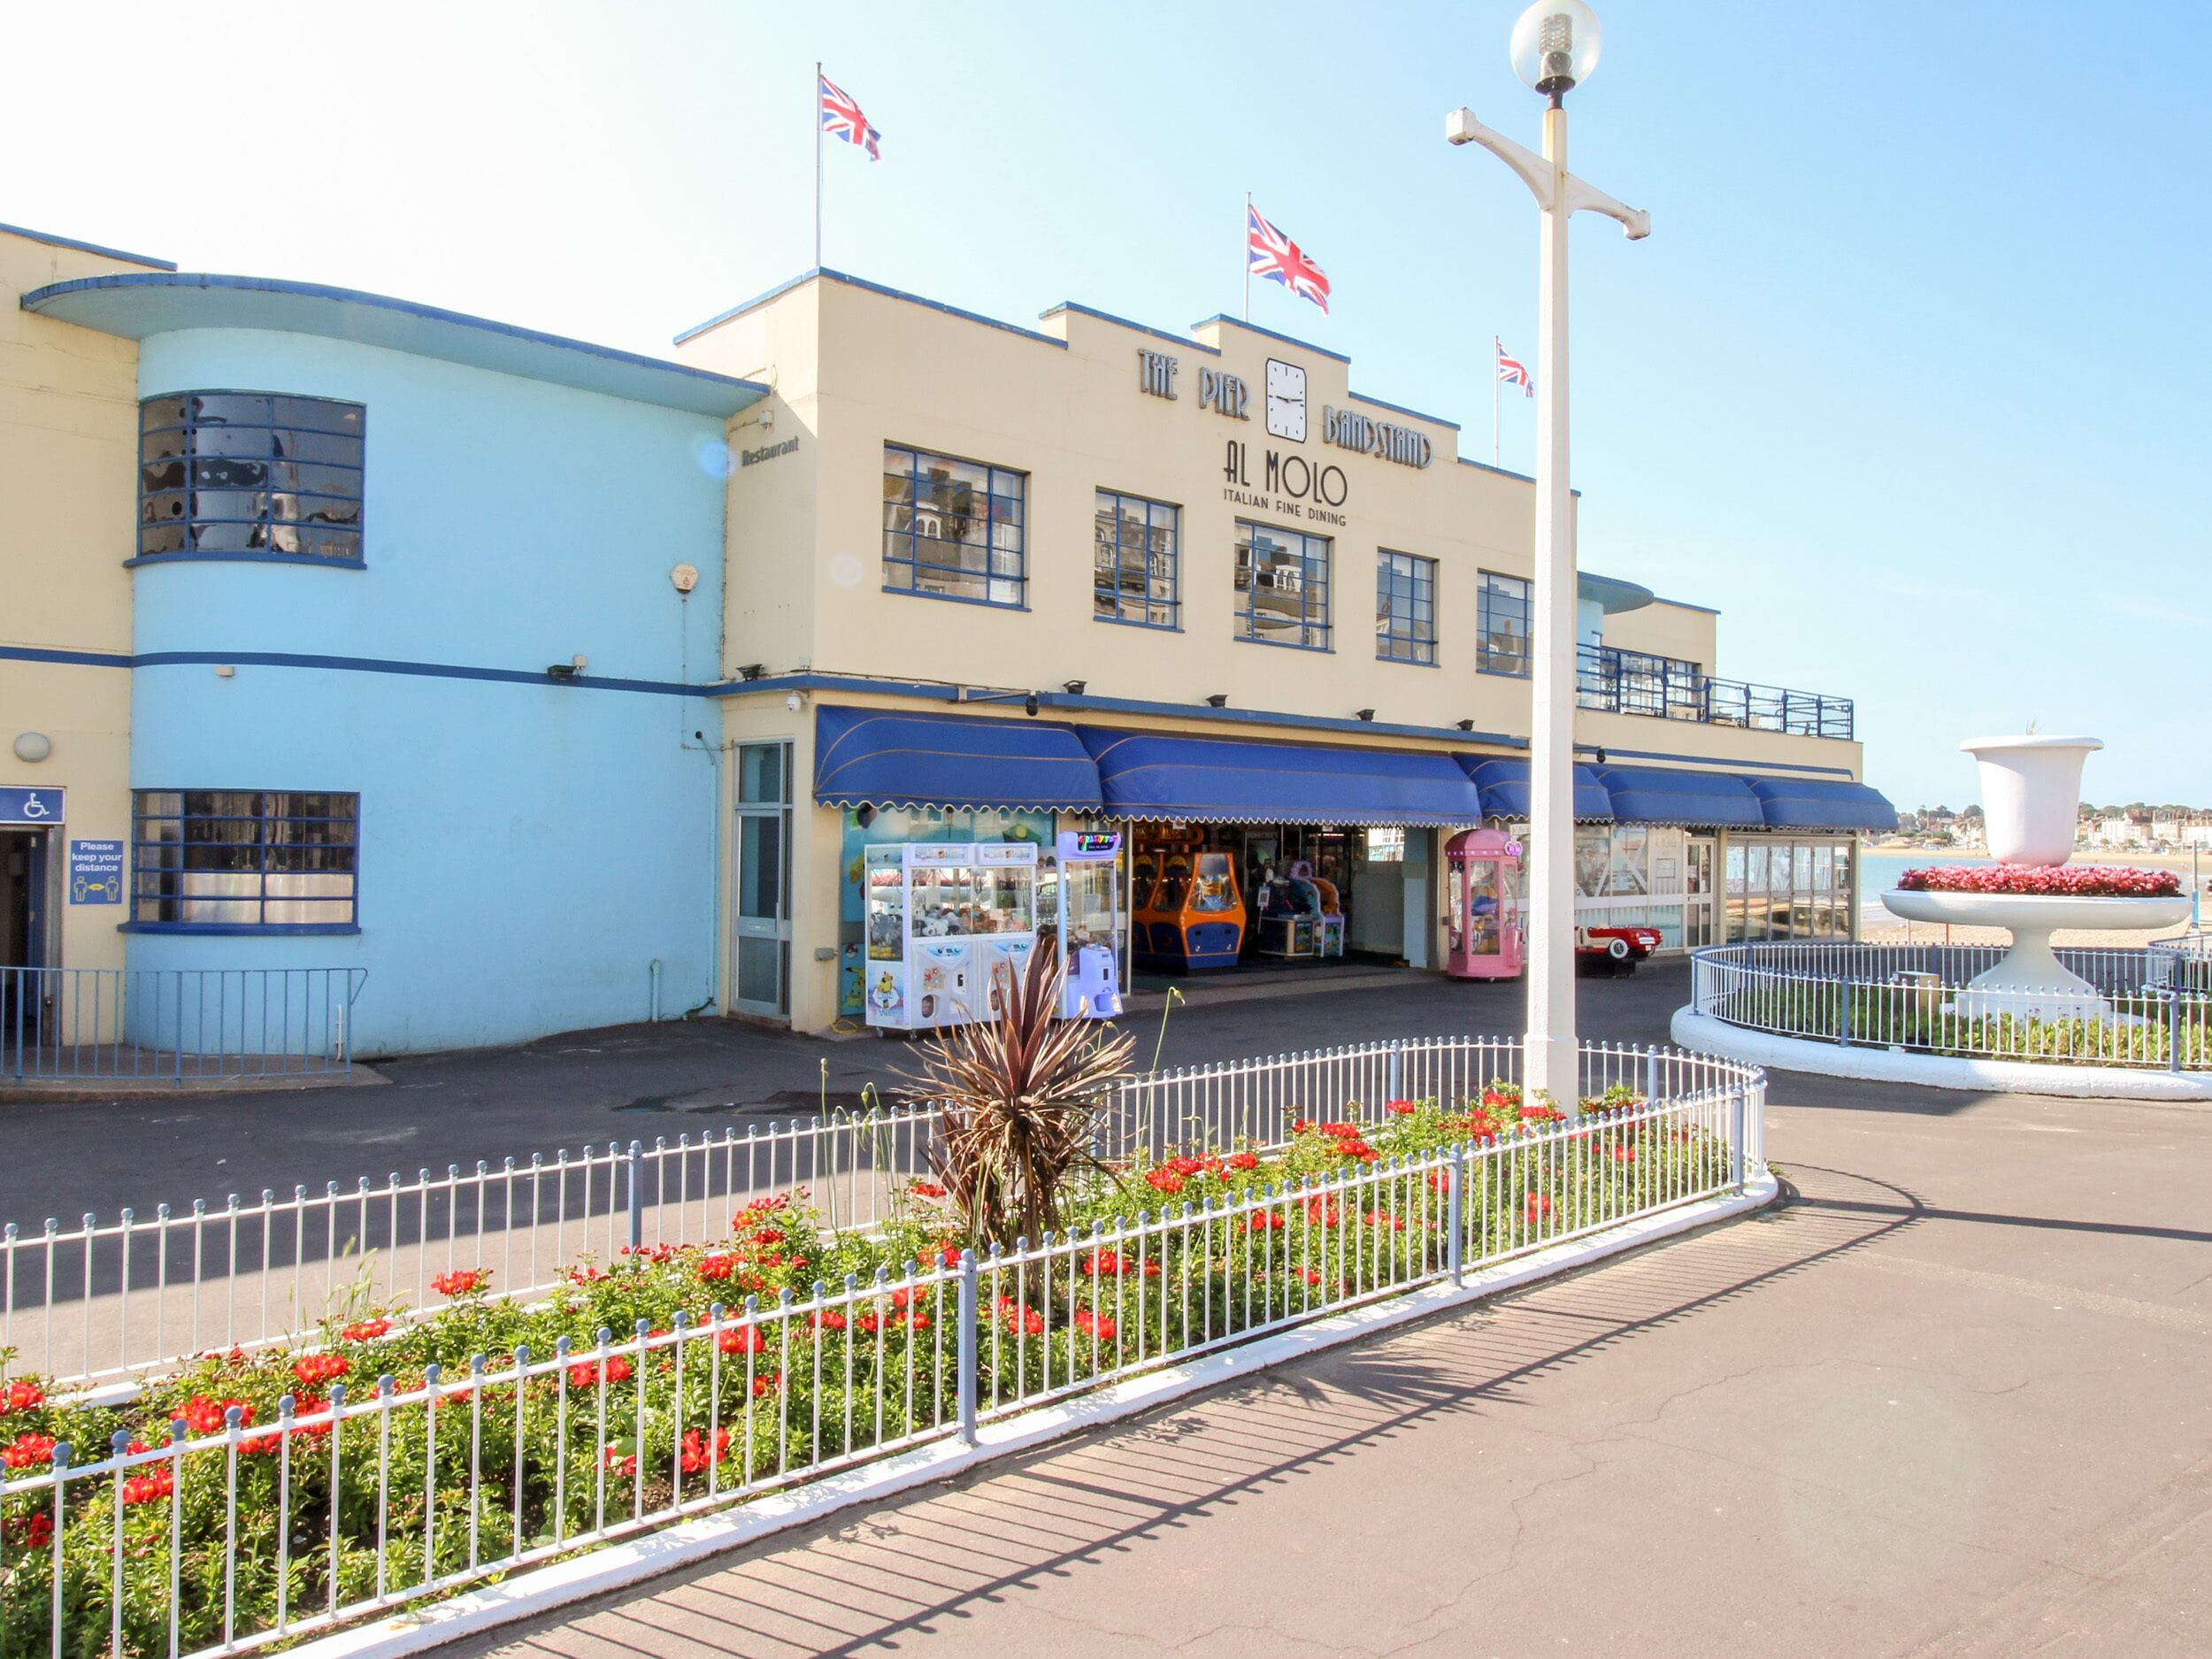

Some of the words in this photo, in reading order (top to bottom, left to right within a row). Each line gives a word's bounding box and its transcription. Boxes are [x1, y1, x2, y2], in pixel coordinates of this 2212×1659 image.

[1138, 349, 1179, 401] THE
[1199, 366, 1250, 422] PIER
[1323, 404, 1433, 470] BANDSTAND
[741, 435, 800, 467] Restaurant
[1224, 440, 1250, 487] AL
[1266, 449, 1348, 507] MOLO
[1224, 488, 1269, 510] ITALIAN
[1276, 501, 1302, 518] FINE
[1308, 508, 1347, 527] DINING
[72, 853, 96, 863] keep
[98, 854, 122, 864] your
[81, 841, 114, 850] Please
